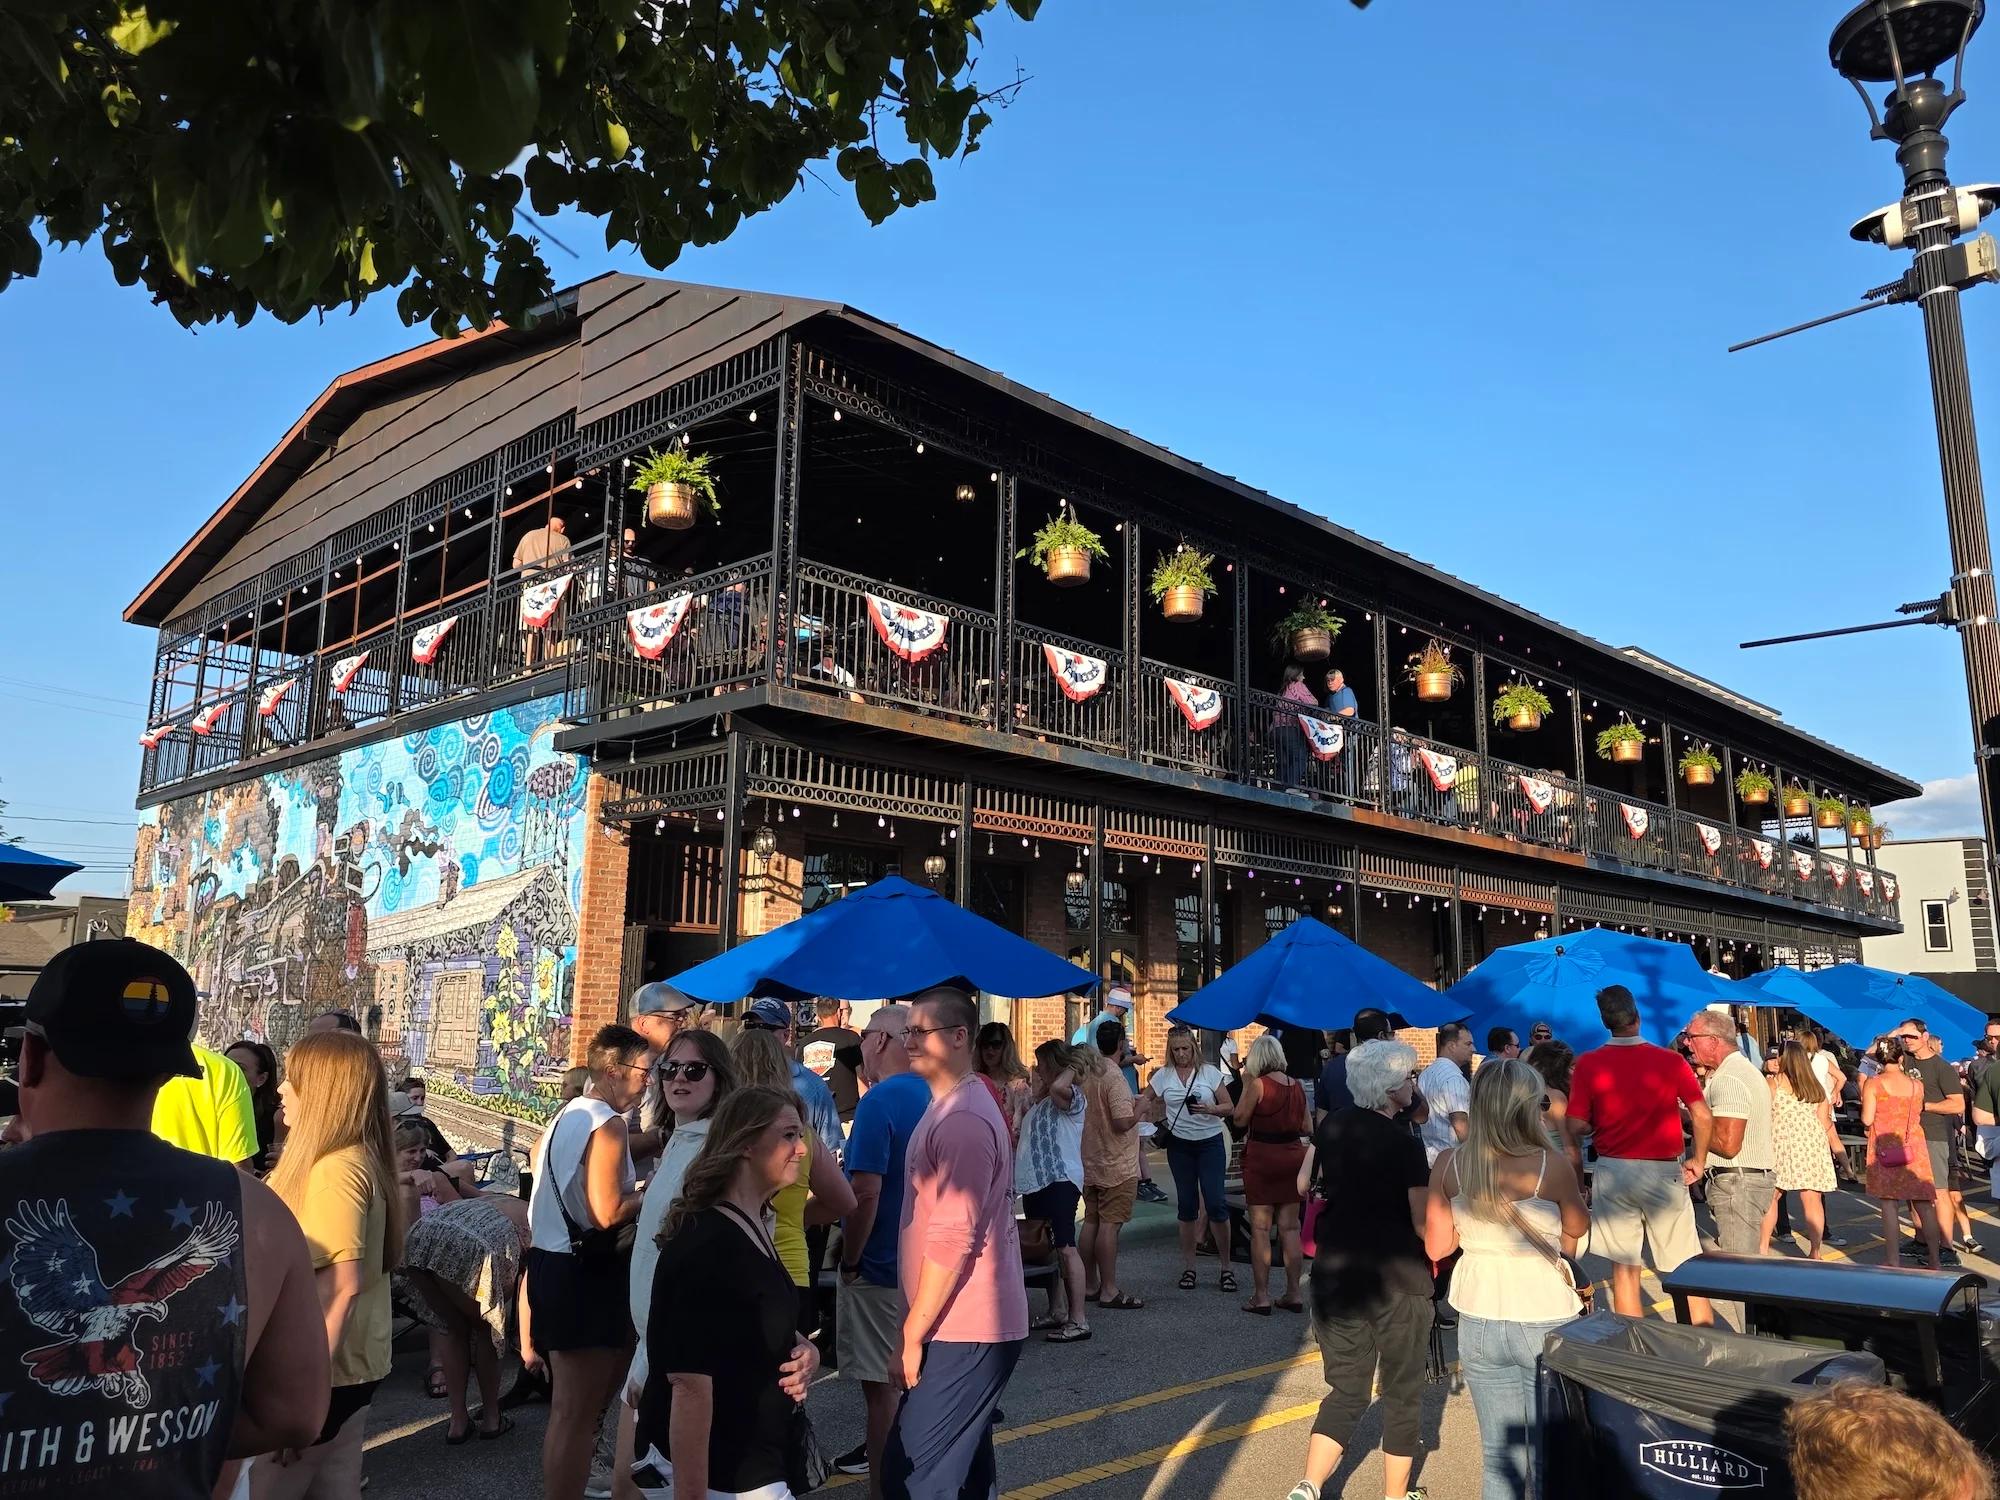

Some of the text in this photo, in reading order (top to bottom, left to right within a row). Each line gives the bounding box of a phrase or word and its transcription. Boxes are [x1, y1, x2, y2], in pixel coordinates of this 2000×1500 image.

[152, 1331, 195, 1351] SINCE
[150, 1350, 185, 1369] 1852
[0, 1425, 62, 1473] ITH
[75, 1420, 95, 1463] &
[108, 1399, 220, 1456] WESSON
[1672, 1443, 1728, 1457] CITY OF
[1654, 1448, 1749, 1479] HILLIARD
